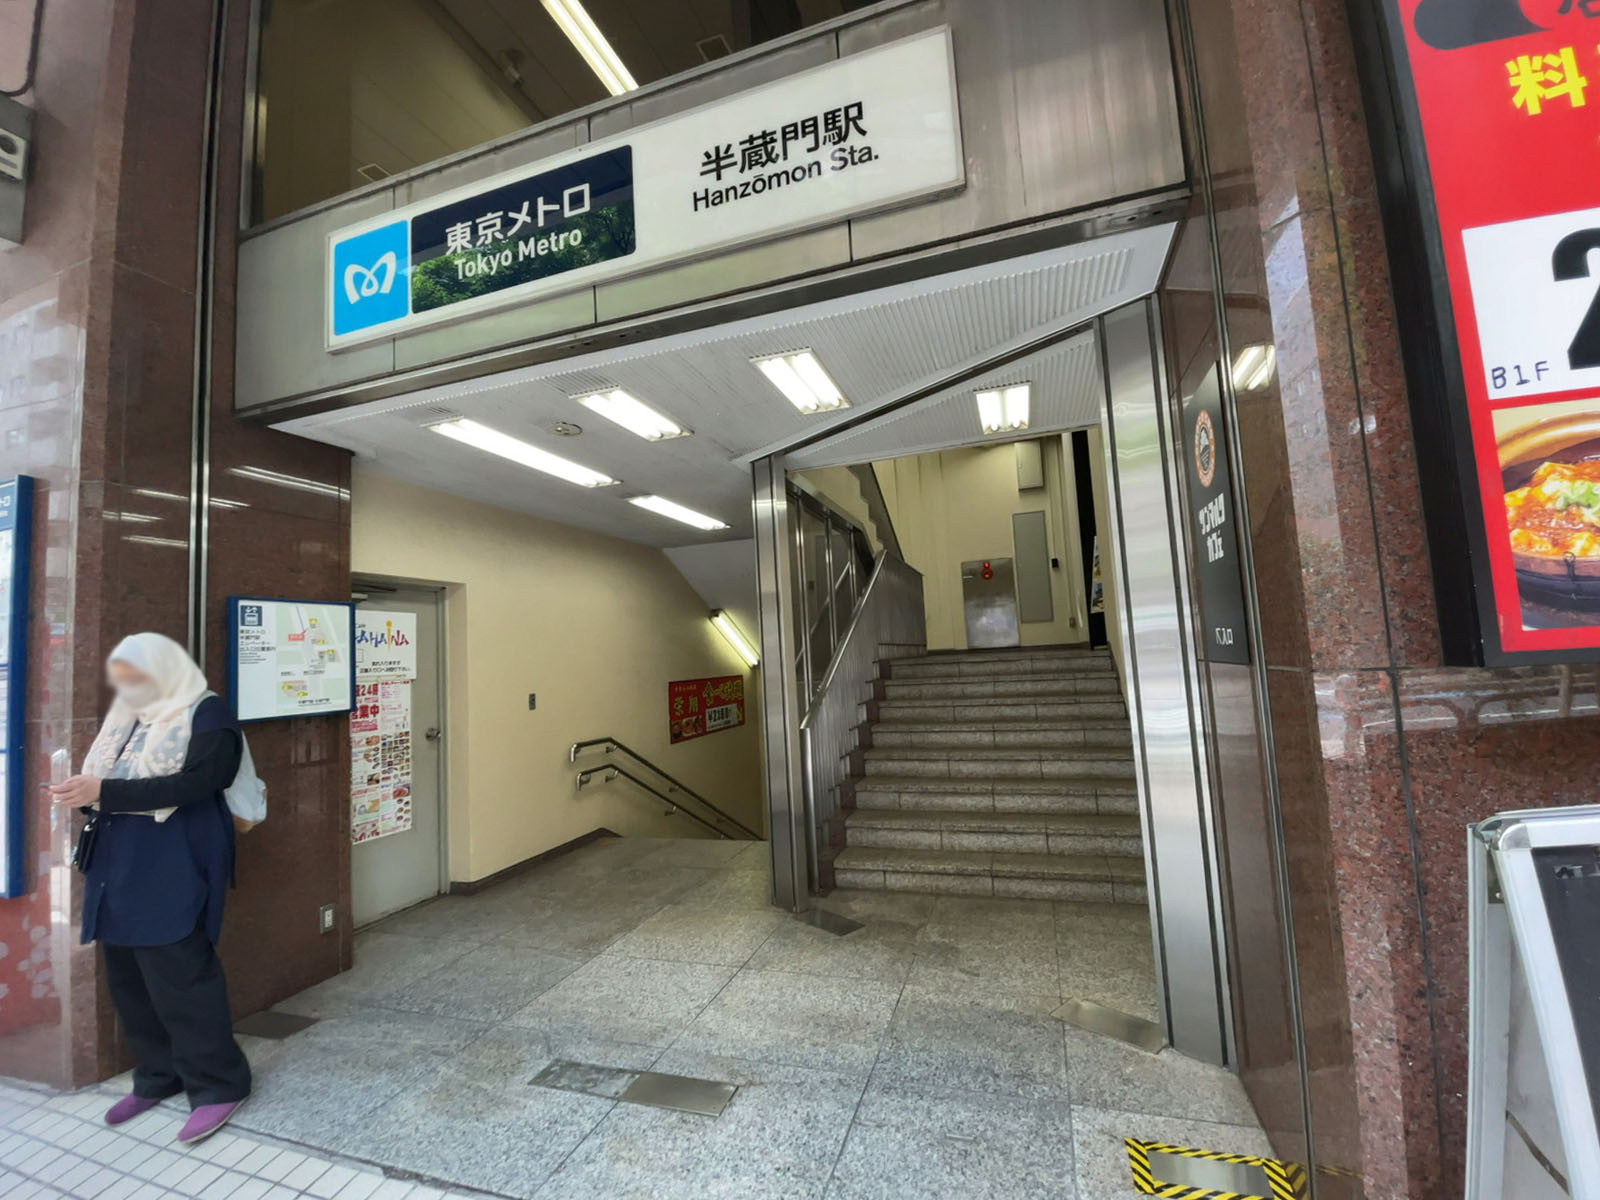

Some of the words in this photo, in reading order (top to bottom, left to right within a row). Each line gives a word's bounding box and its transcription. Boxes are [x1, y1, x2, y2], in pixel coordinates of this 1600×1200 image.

[1505, 44, 1600, 116] 料
[699, 101, 868, 181] 半蔵門駅
[692, 159, 823, 211] Hanzōmon
[830, 145, 880, 172] Sta.
[445, 183, 591, 256] 東京メトロ
[454, 247, 513, 280] Tokyo
[518, 228, 583, 263] Metro
[1490, 360, 1551, 390] B1F
[355, 620, 410, 650] AHAINA
